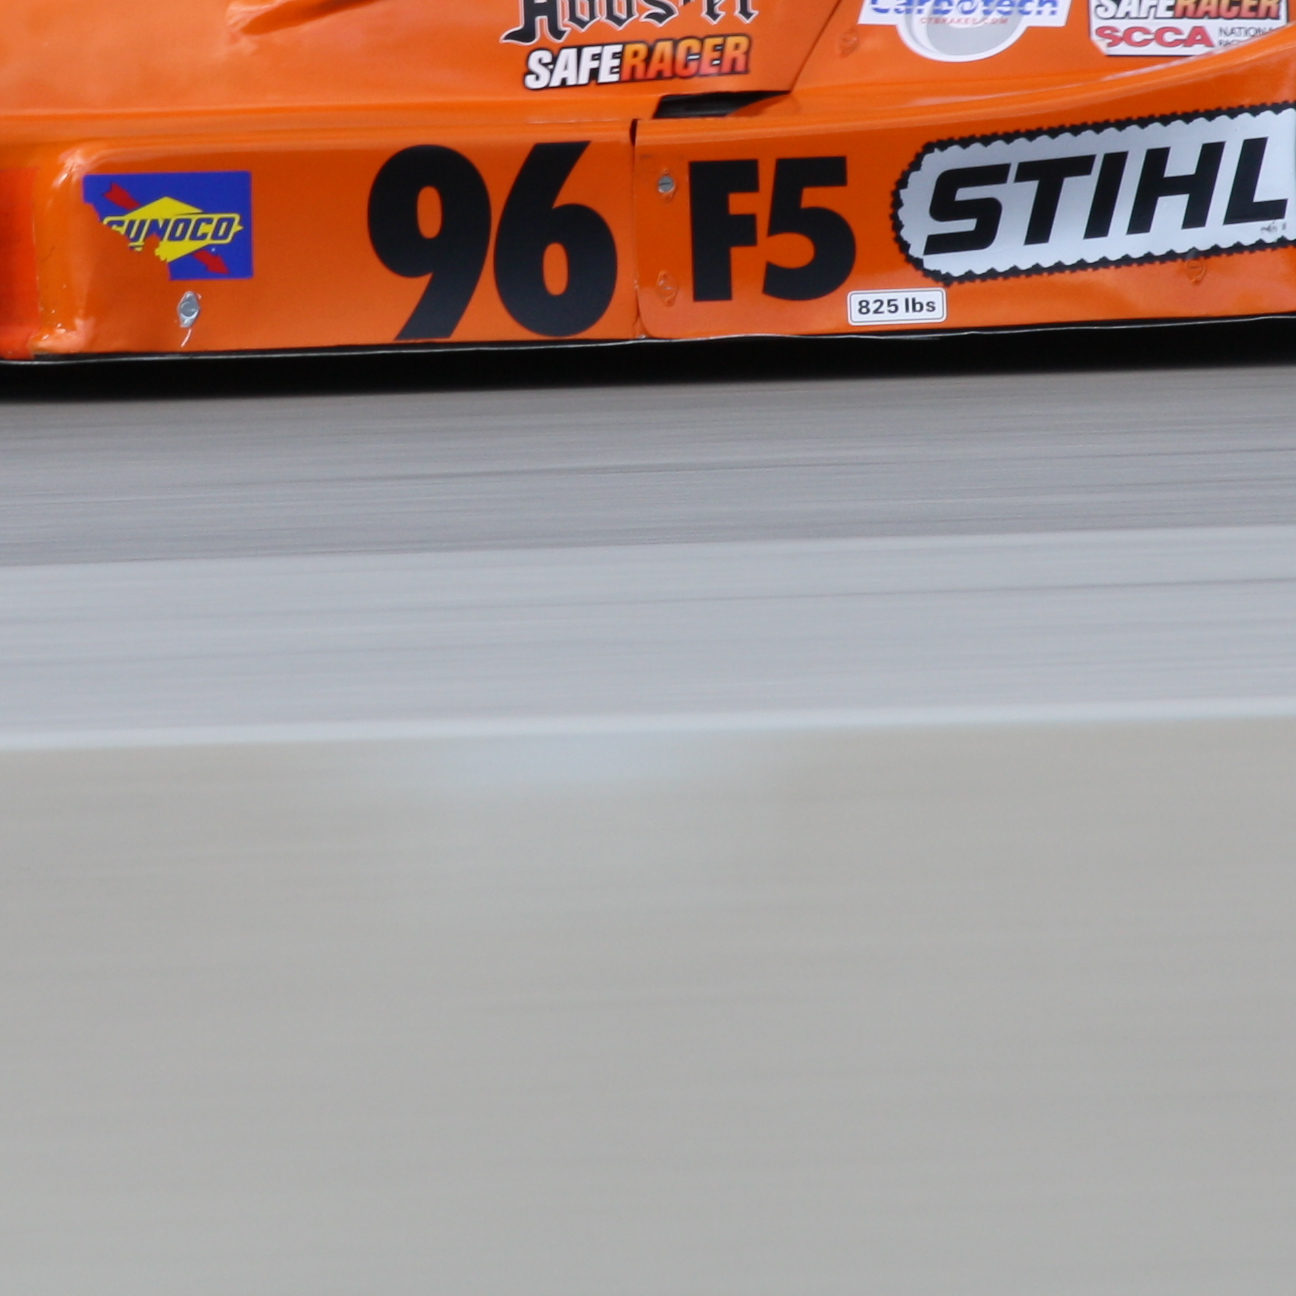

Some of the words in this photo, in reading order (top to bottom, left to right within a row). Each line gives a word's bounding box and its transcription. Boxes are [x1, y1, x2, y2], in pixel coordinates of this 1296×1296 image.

[524, 34, 751, 89] SAFERACER
[1095, 25, 1214, 48] SCCA
[689, 156, 856, 301] F5
[923, 137, 1288, 255] STIHL
[367, 141, 618, 340] 96
[857, 298, 899, 315] 825
[904, 297, 936, 313] lbs
